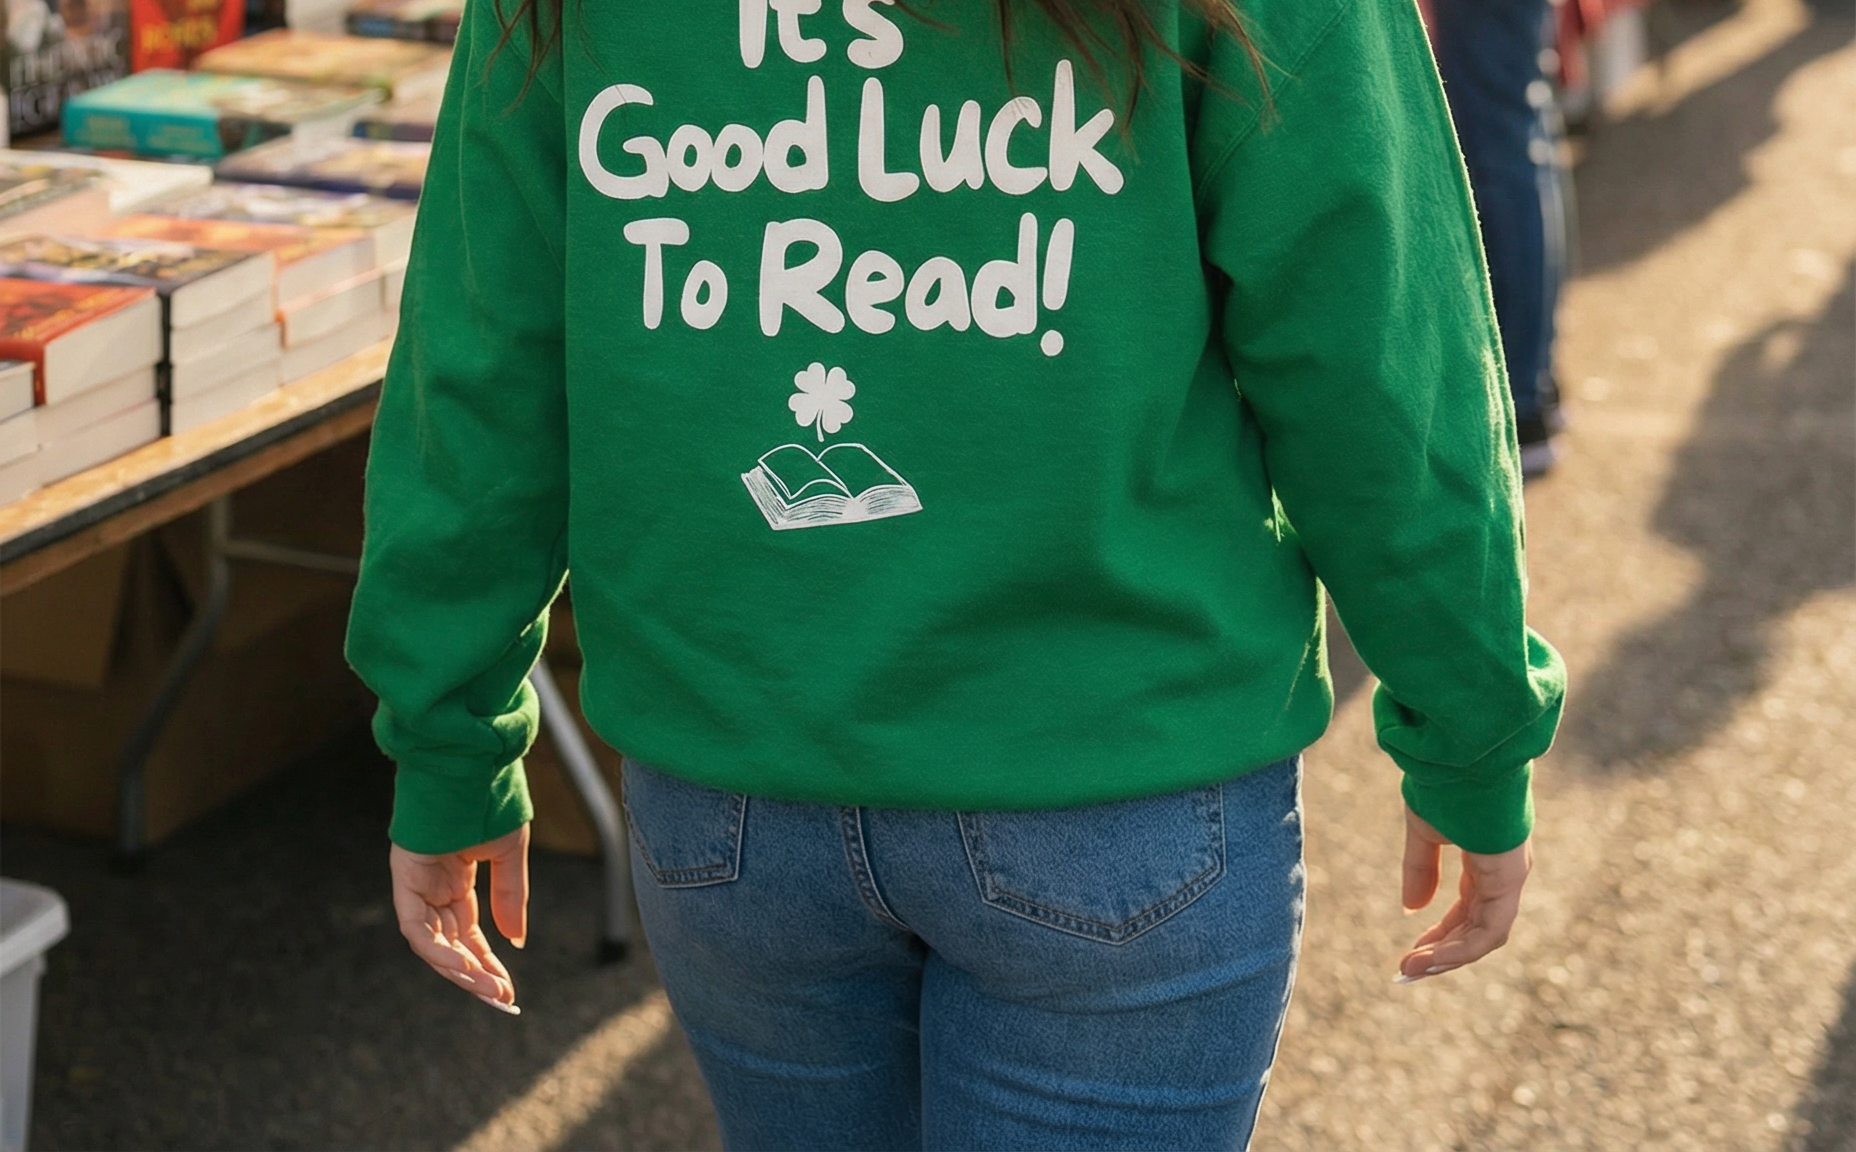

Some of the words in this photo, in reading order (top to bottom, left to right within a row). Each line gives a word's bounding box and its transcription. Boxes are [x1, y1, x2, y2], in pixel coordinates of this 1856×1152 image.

[578, 75, 829, 200] Good
[857, 58, 1124, 203] Luck
[623, 217, 728, 330] To
[758, 212, 1075, 357] Read!
